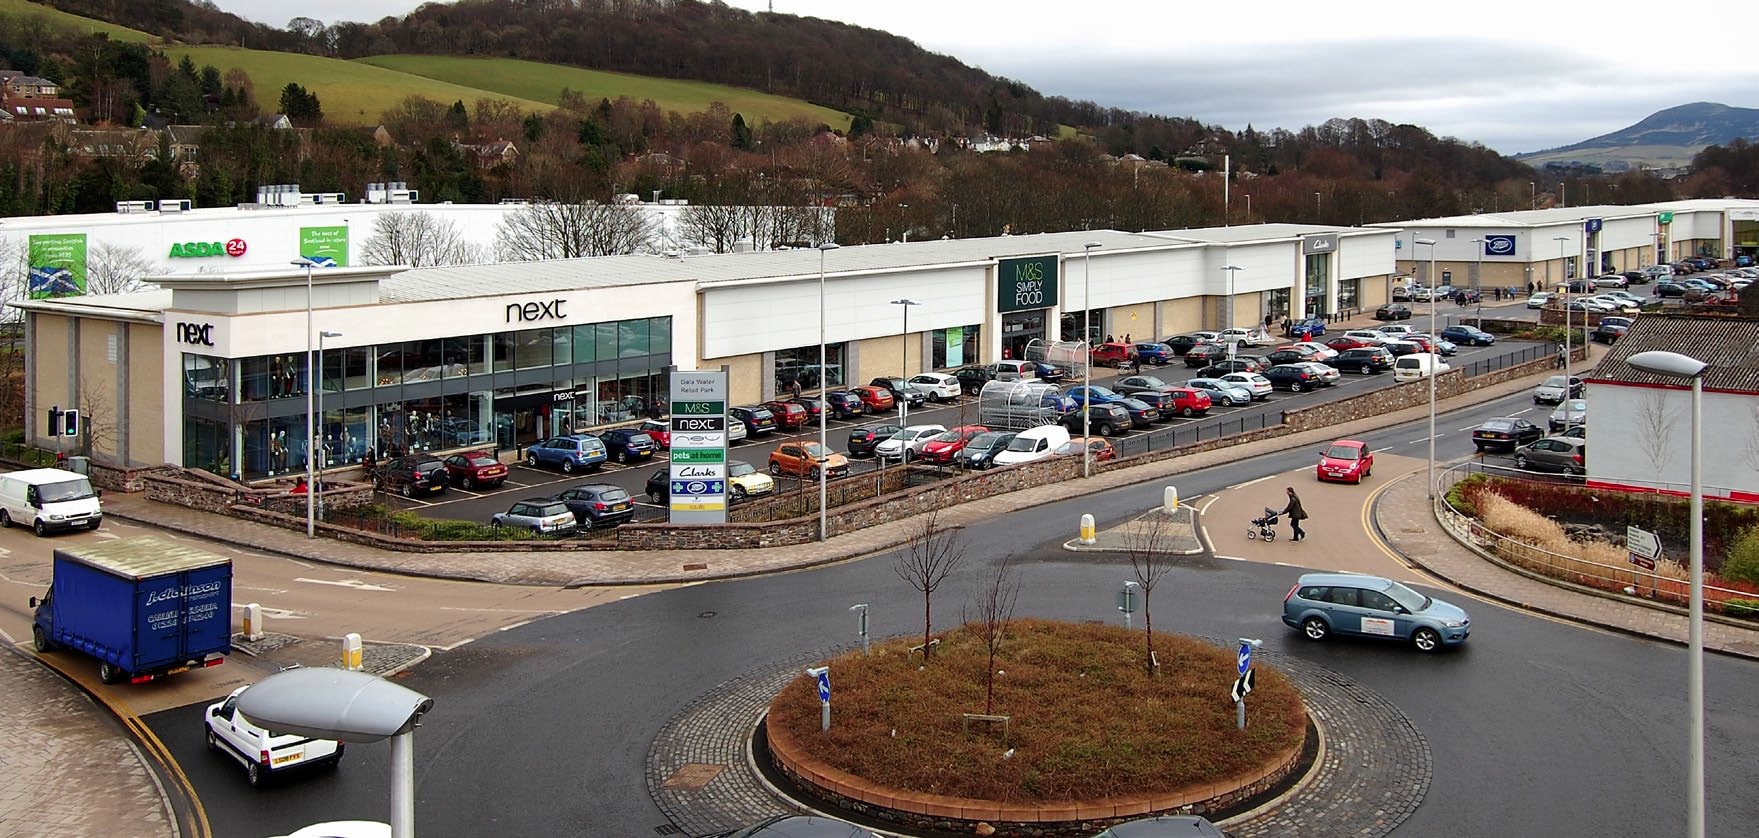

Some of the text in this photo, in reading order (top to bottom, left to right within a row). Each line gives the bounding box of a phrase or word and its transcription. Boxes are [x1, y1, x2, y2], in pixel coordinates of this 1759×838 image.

[169, 242, 225, 258] ASDA
[229, 241, 245, 251] 24
[1016, 262, 1043, 281] M&S
[1016, 280, 1043, 293] SIMPLY
[1015, 291, 1043, 306] FOOD
[506, 299, 567, 323] next
[176, 322, 215, 347] next
[553, 391, 576, 401] next
[684, 403, 711, 414] M&S
[679, 419, 716, 430] next
[673, 451, 690, 460] pets
[679, 466, 716, 477] Clarks
